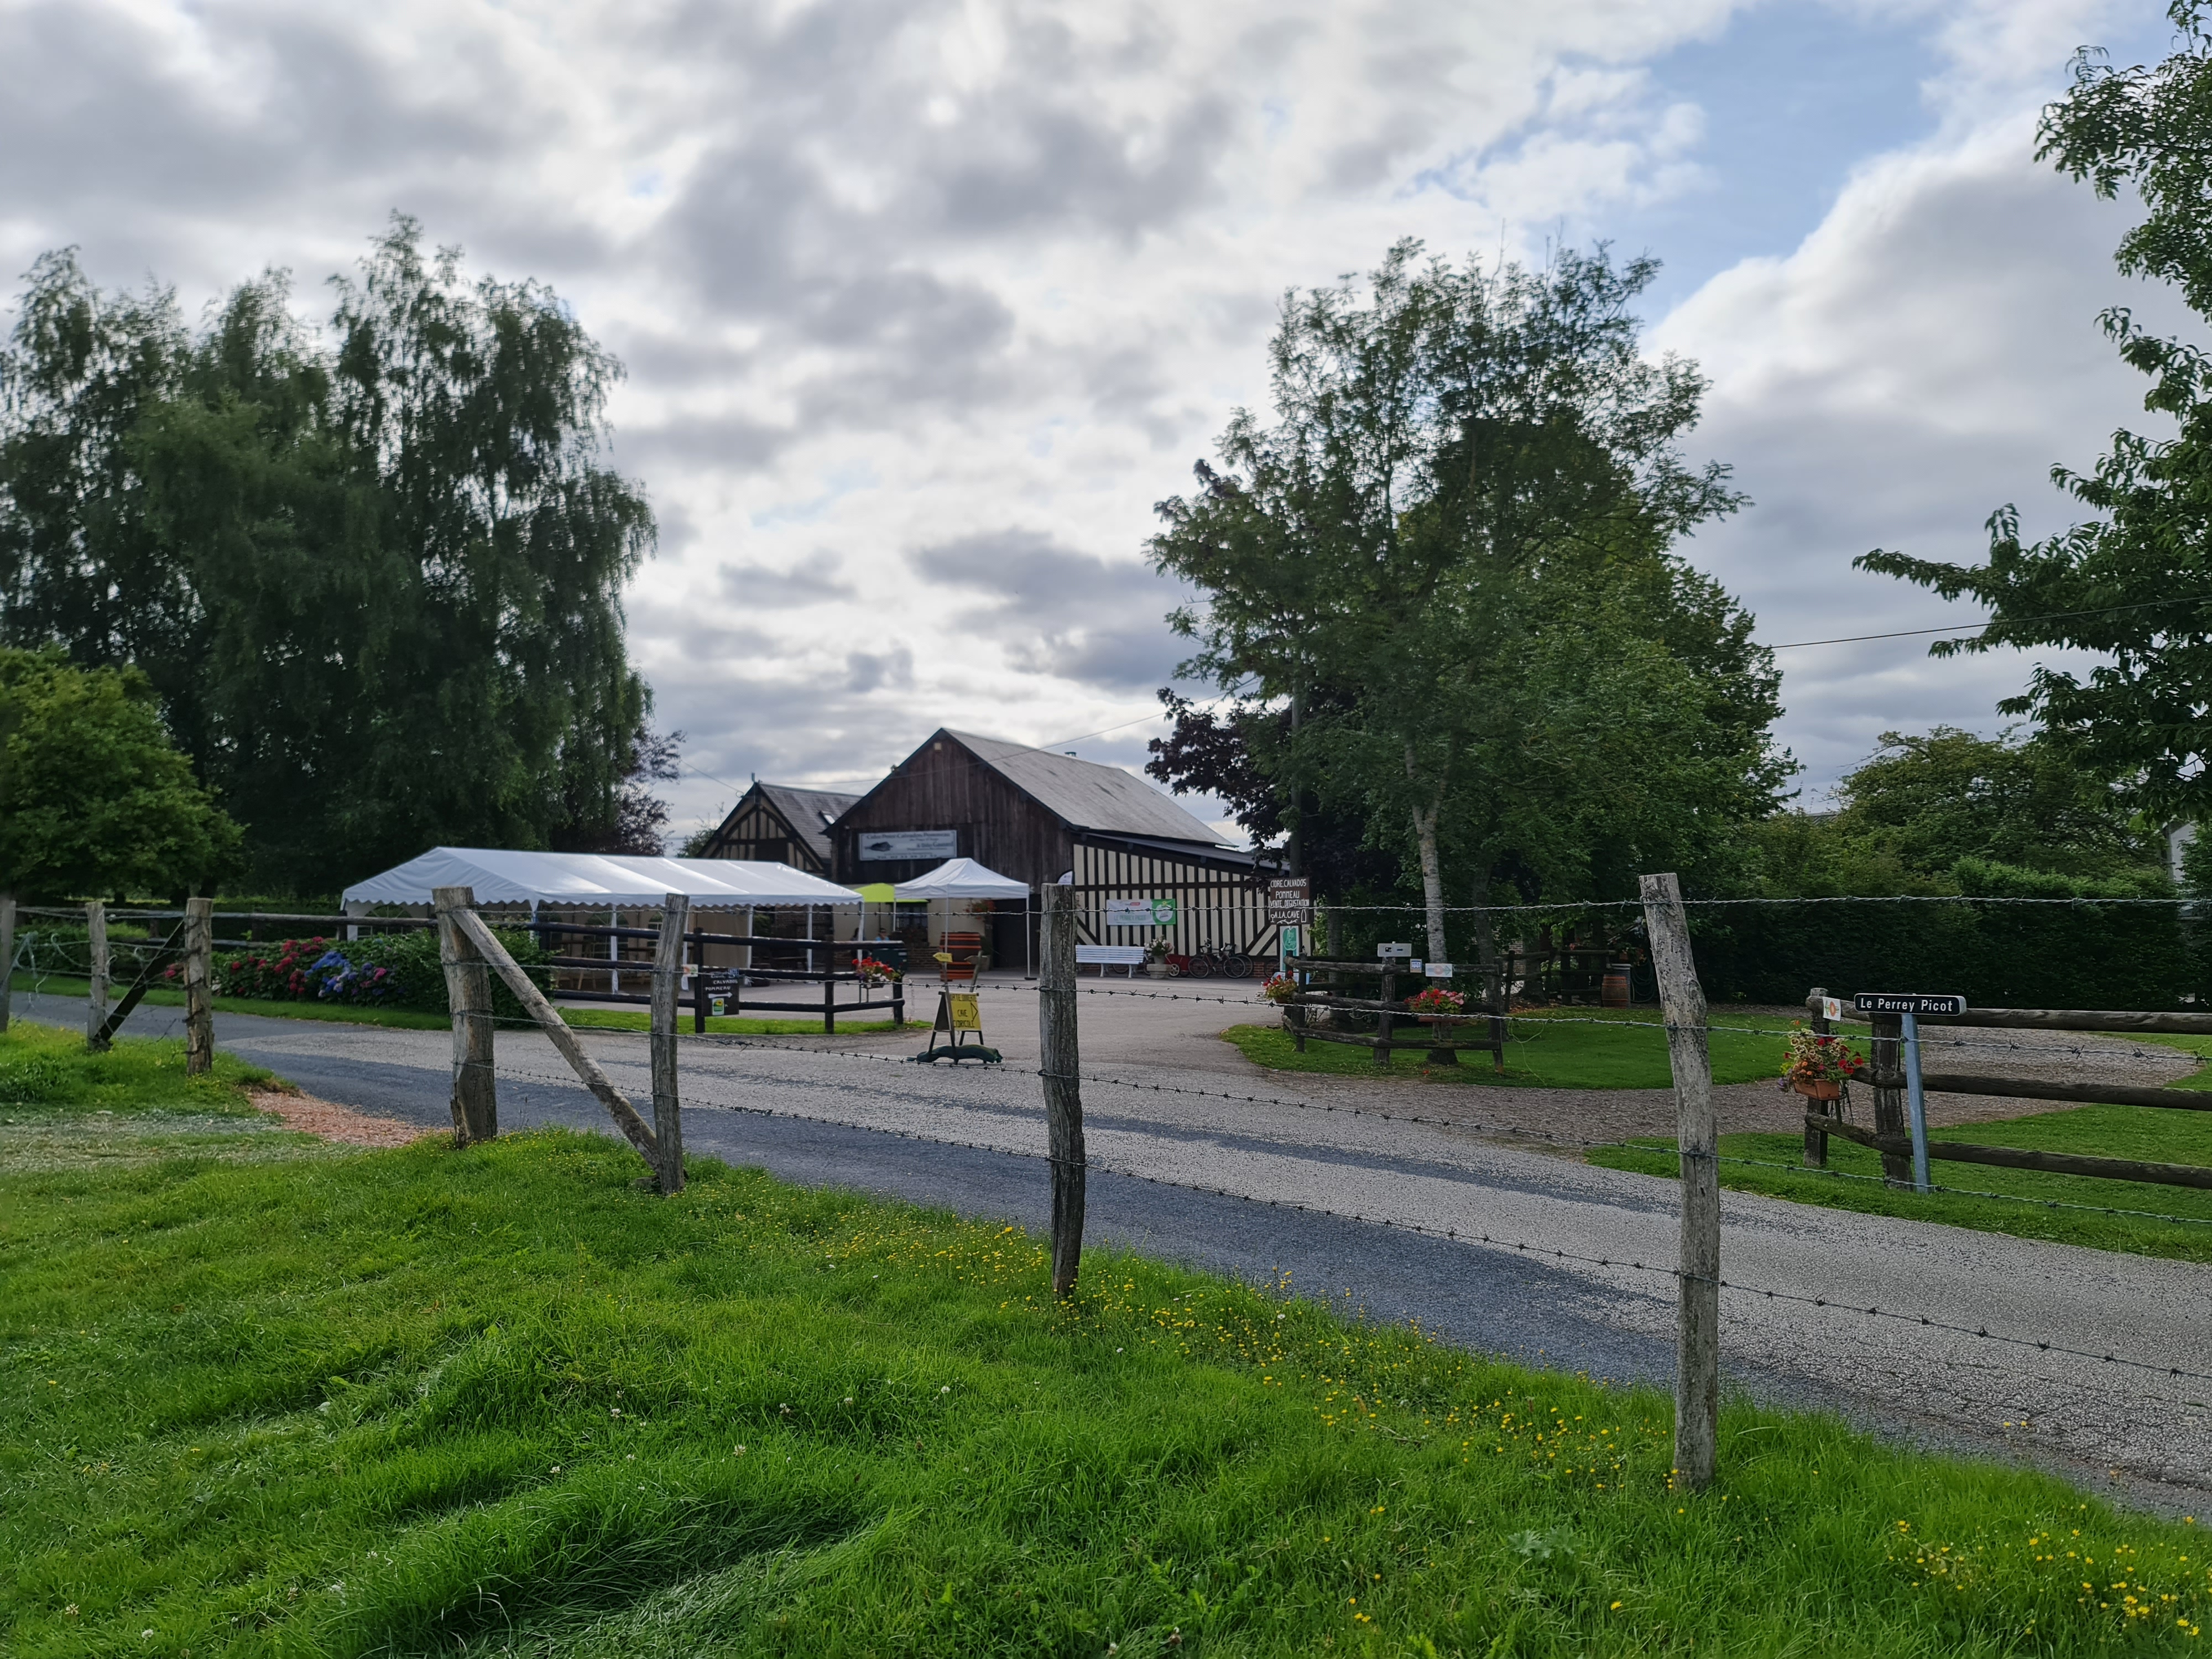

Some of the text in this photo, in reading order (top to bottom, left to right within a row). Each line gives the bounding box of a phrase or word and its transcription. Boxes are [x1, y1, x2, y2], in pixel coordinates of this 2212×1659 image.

[1275, 890, 1300, 899] POMMEAU
[1860, 998, 1953, 1012] Le Perrey Picot
